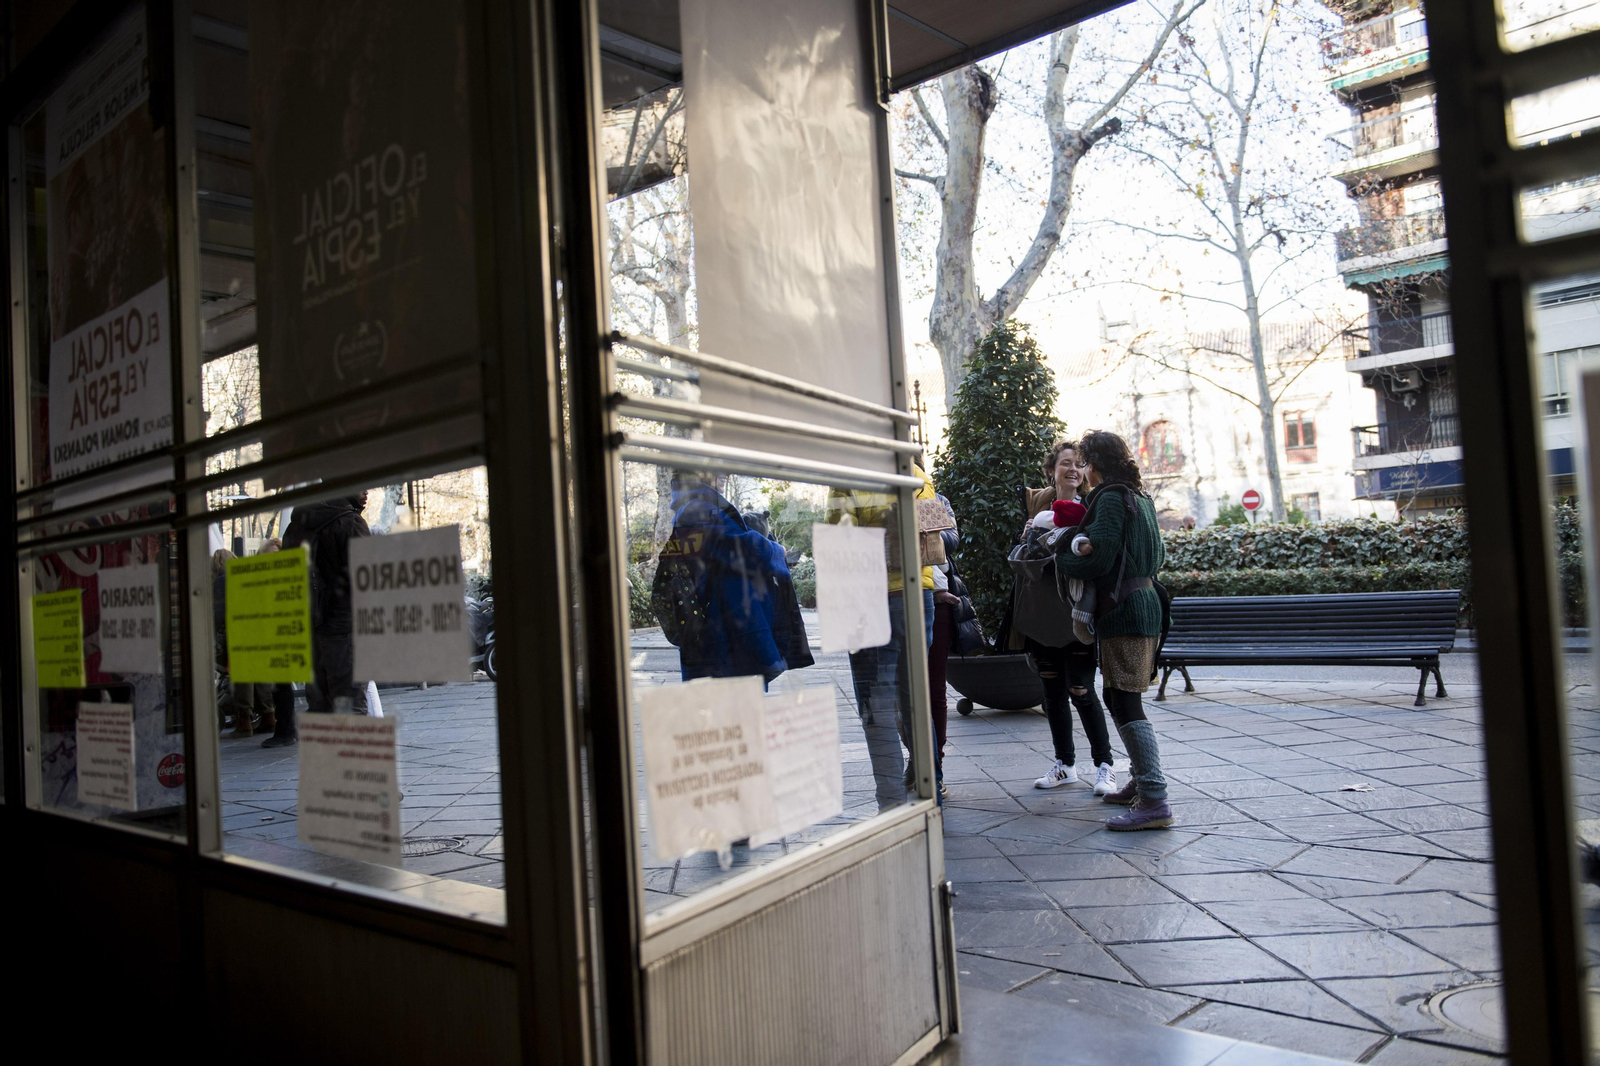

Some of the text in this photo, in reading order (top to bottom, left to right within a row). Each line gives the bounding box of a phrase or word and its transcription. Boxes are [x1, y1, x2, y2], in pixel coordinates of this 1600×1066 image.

[1434, 496, 1466, 507] PION
[723, 724, 743, 741] CINE
[655, 772, 710, 799] EXCLUSIVA
